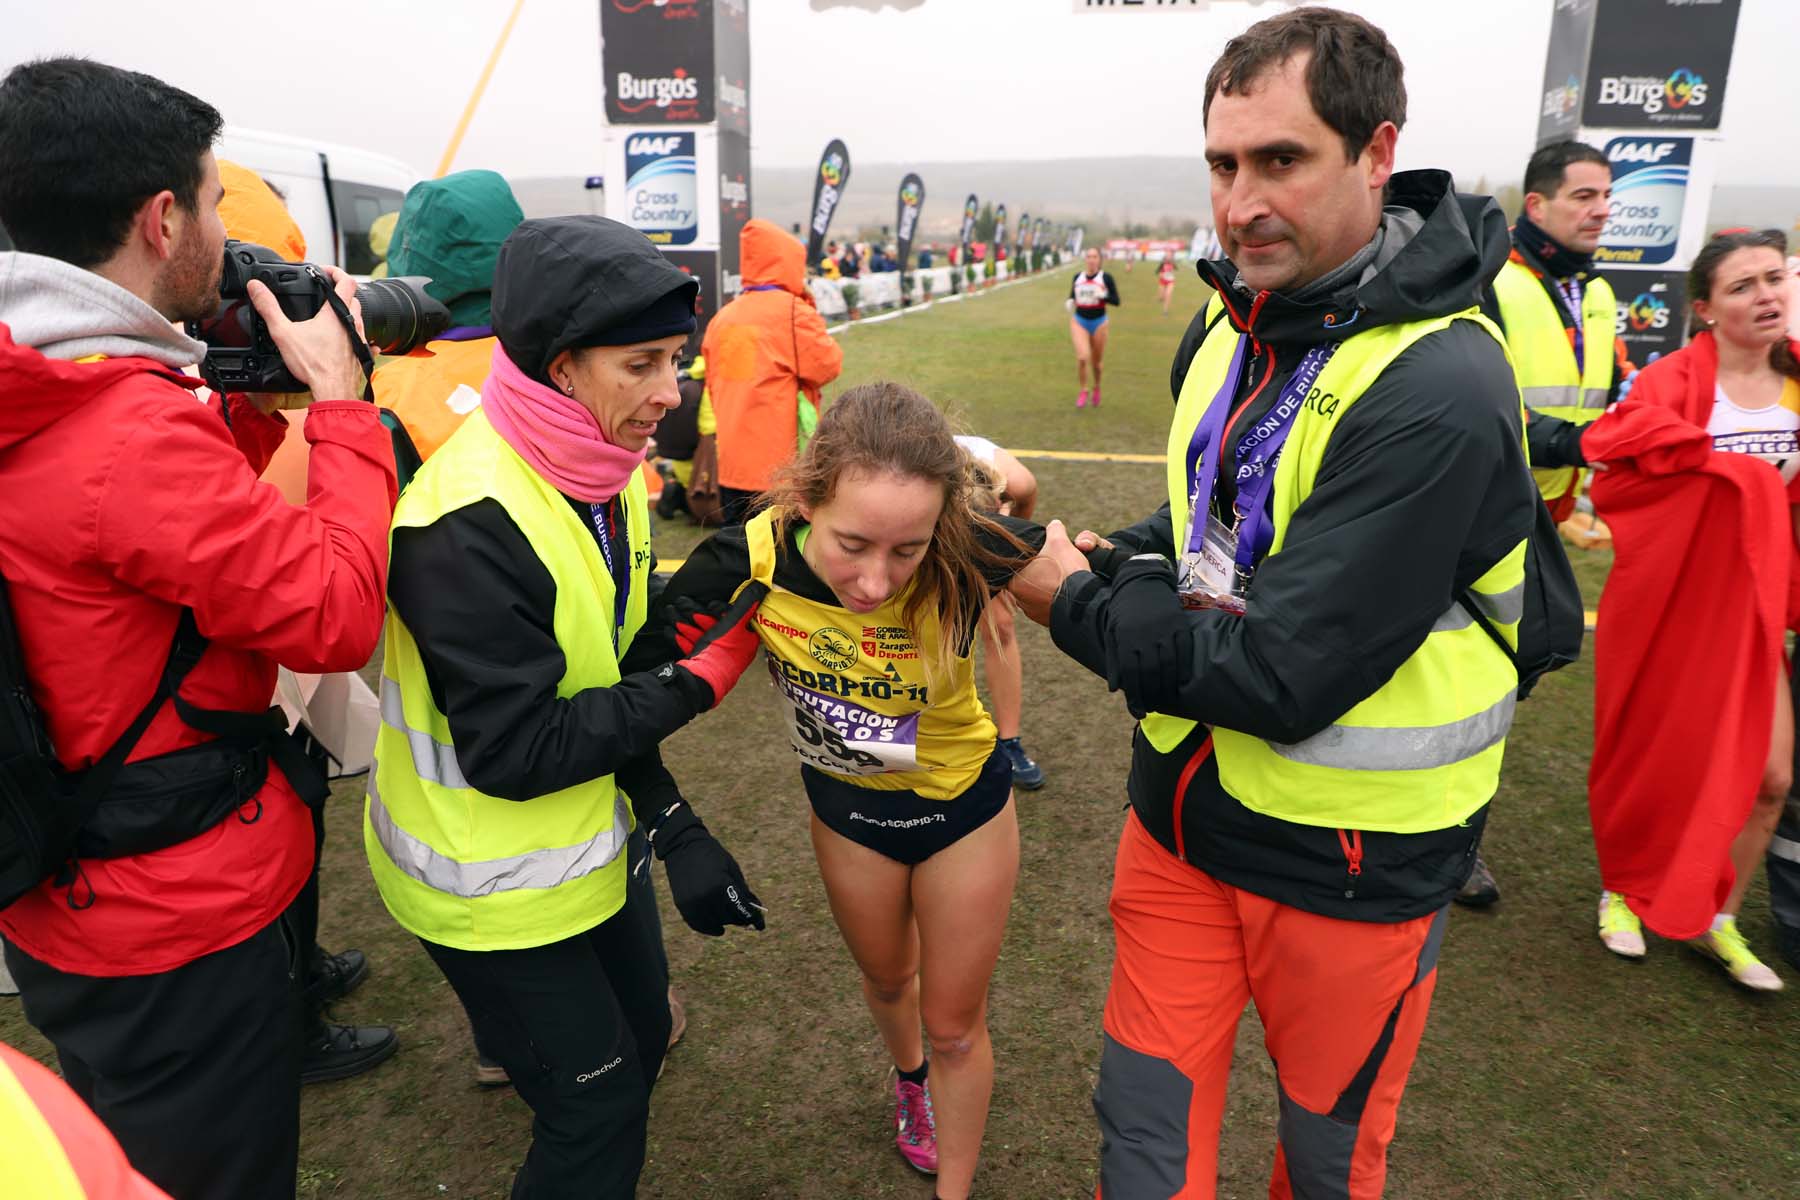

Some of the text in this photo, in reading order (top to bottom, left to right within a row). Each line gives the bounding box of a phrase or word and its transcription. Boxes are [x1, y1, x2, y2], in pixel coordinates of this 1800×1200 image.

[617, 72, 698, 107] Burgos
[1598, 67, 1708, 113] Burgos
[628, 137, 682, 155] IAAF
[1608, 142, 1676, 163] IAAF
[635, 189, 678, 205] Cross
[632, 206, 692, 225] Country
[1592, 247, 1644, 262] Permit
[1276, 394, 1300, 420] DE
[756, 614, 808, 639] lcampo
[576, 1056, 622, 1082] Quechua
